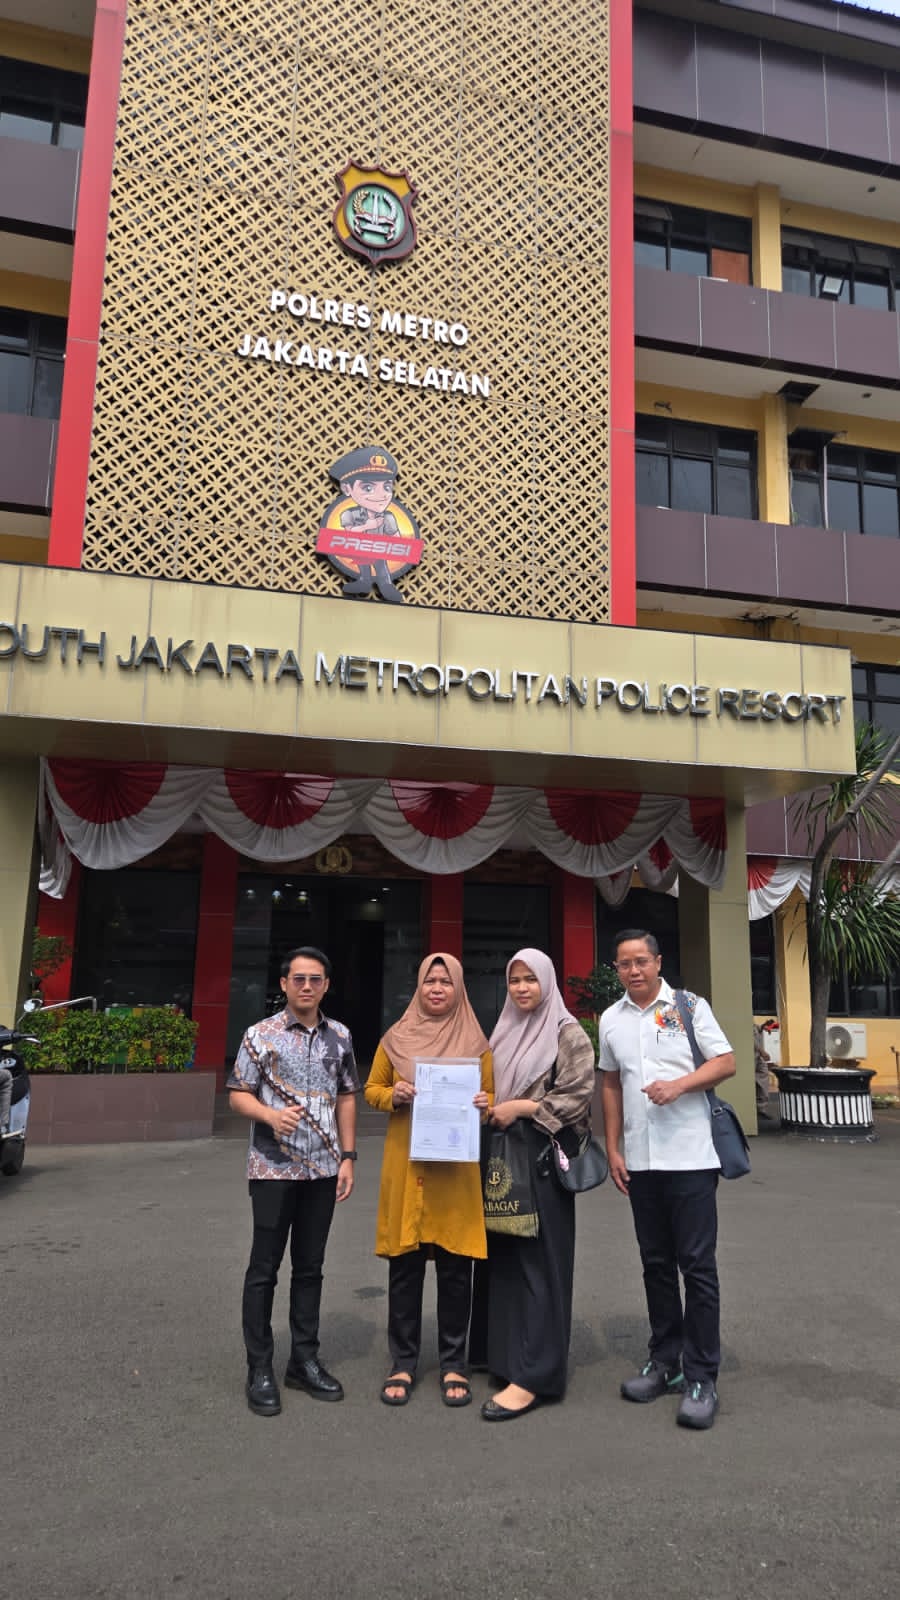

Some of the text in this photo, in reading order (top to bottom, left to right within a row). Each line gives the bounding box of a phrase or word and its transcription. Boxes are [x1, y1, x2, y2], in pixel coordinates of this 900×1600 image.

[270, 291, 468, 346] POLRES METRO
[237, 334, 490, 397] JAKARTA SELATAN
[330, 535, 411, 555] PRESISI
[0, 621, 846, 723] OUTH JAKARTA METROPOLITAN POLICE RESORT
[484, 1199, 520, 1213] ABAGAF
